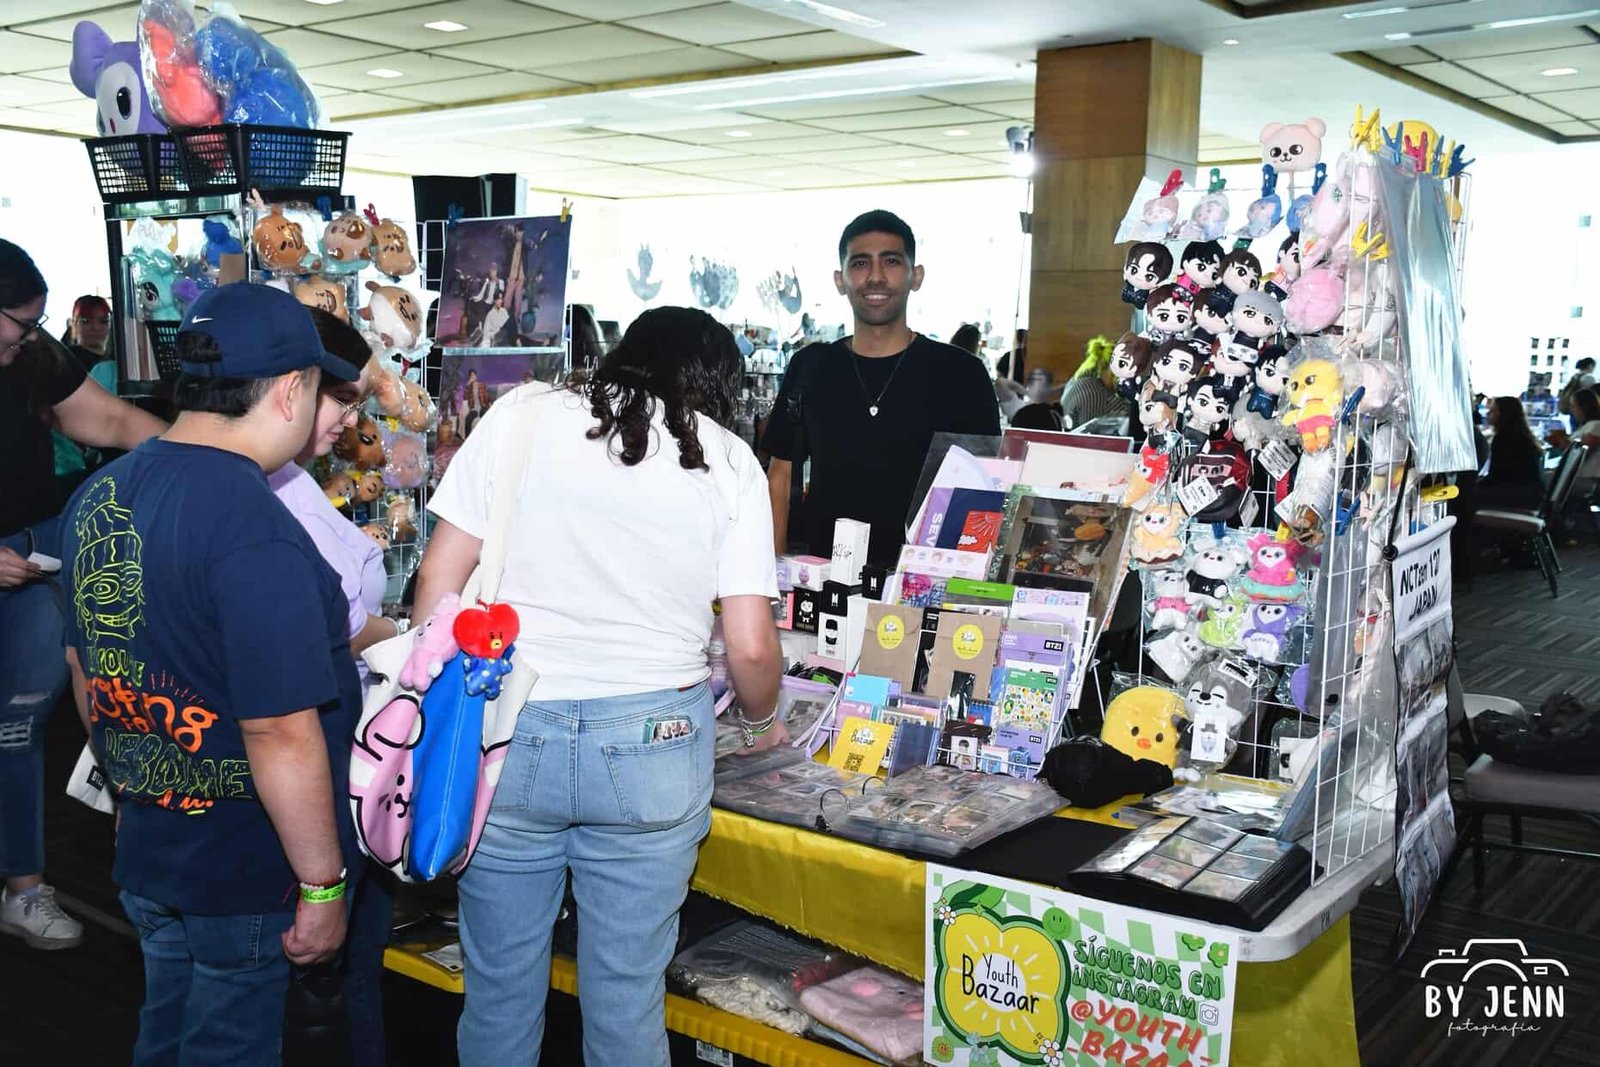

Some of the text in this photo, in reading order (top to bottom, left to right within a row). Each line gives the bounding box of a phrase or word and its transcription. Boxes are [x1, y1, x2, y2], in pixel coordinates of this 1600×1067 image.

[1408, 583, 1438, 622] JAPAN
[962, 953, 1040, 1014] Bazaar
[982, 952, 1018, 989] Youth
[1073, 934, 1221, 1001] SÍGUENOS EN
